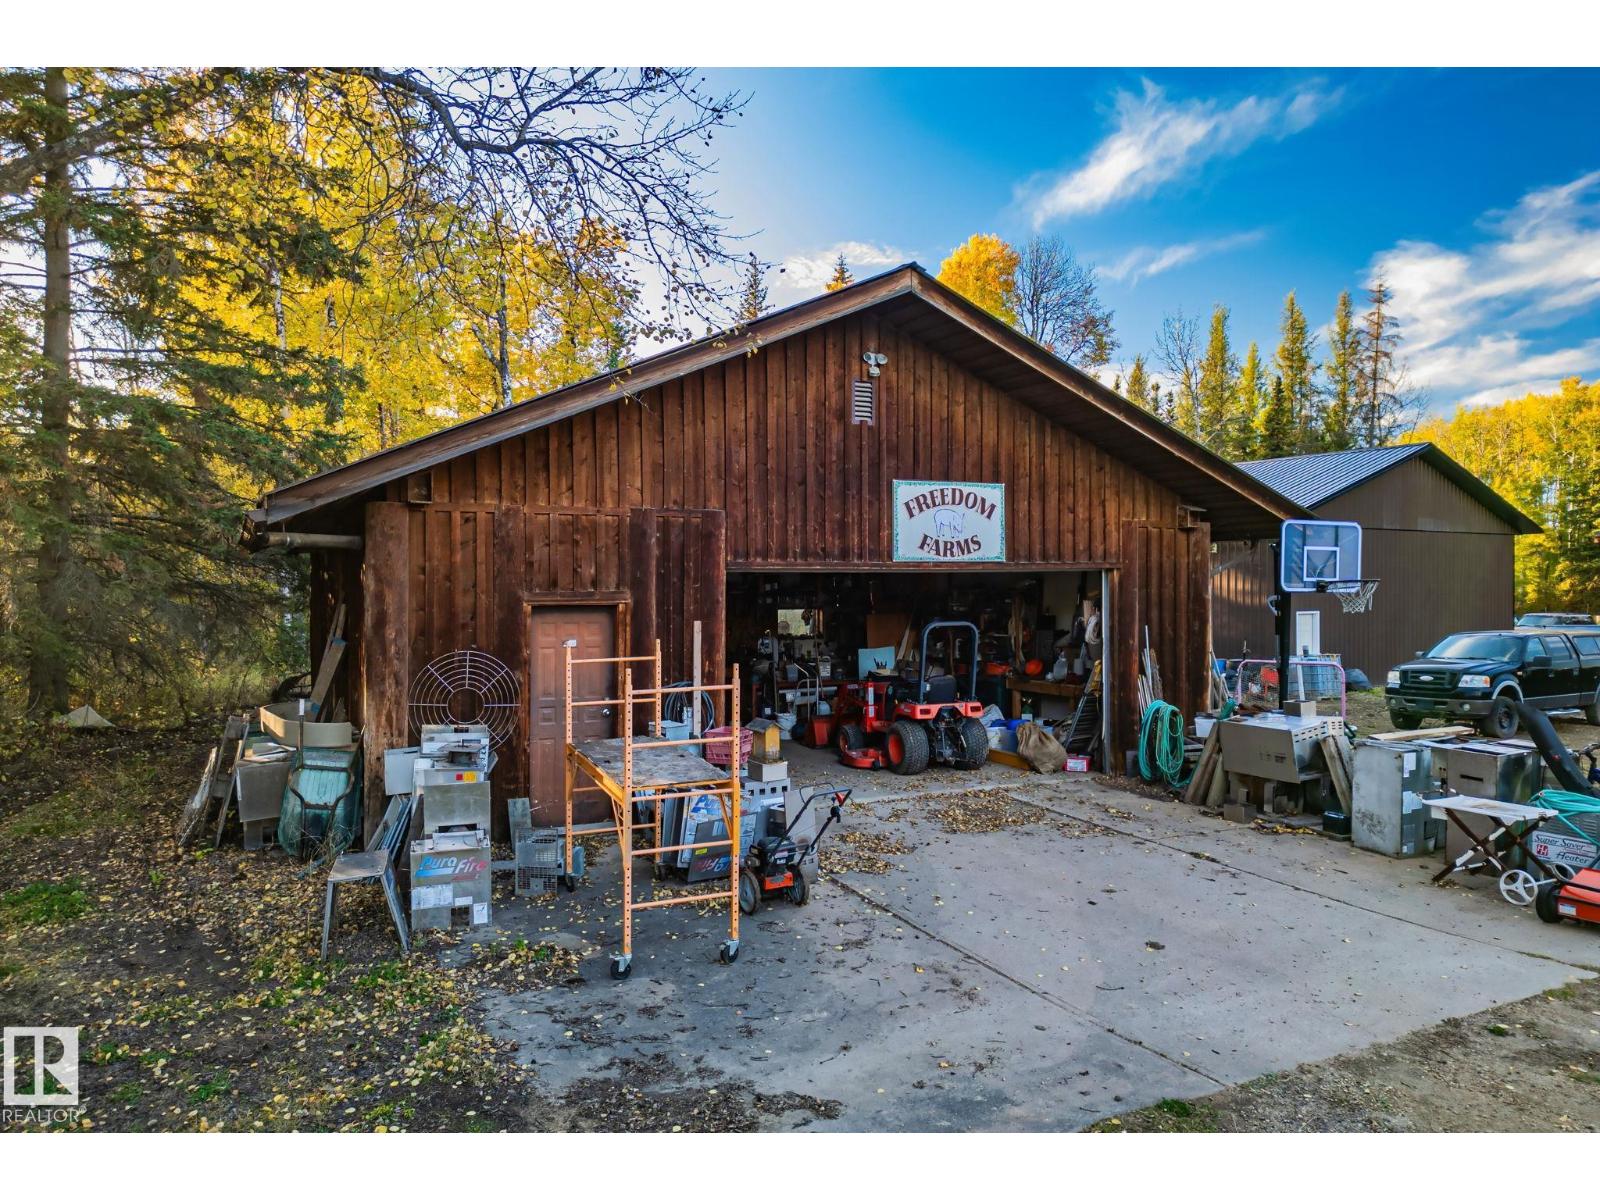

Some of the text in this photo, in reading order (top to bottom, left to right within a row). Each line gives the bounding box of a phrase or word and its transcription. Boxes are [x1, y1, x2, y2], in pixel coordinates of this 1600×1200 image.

[904, 487, 997, 520] FREEDOM
[918, 533, 982, 557] FARMS
[1534, 835, 1586, 850] Super Saver
[1557, 852, 1589, 864] Heater
